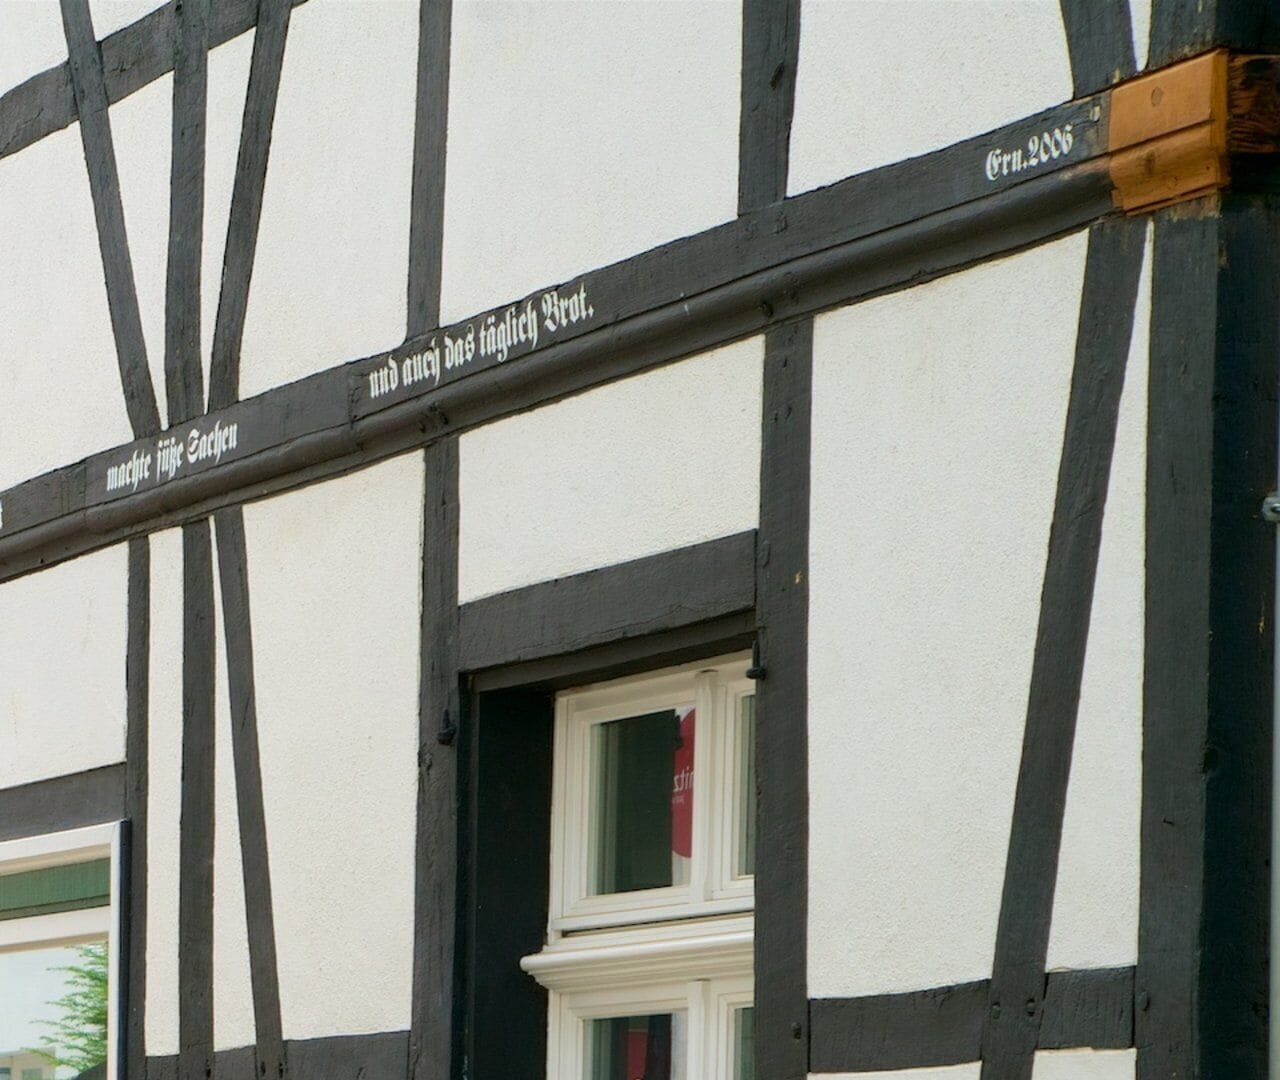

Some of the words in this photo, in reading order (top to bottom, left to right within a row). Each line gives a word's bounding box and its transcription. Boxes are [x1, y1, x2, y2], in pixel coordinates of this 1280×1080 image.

[369, 356, 399, 399] und
[403, 338, 441, 386] auch
[445, 324, 475, 370] das
[479, 299, 538, 363] täglich
[542, 282, 594, 333] Brot.
[106, 448, 152, 492] machte
[187, 419, 238, 464] Sachen
